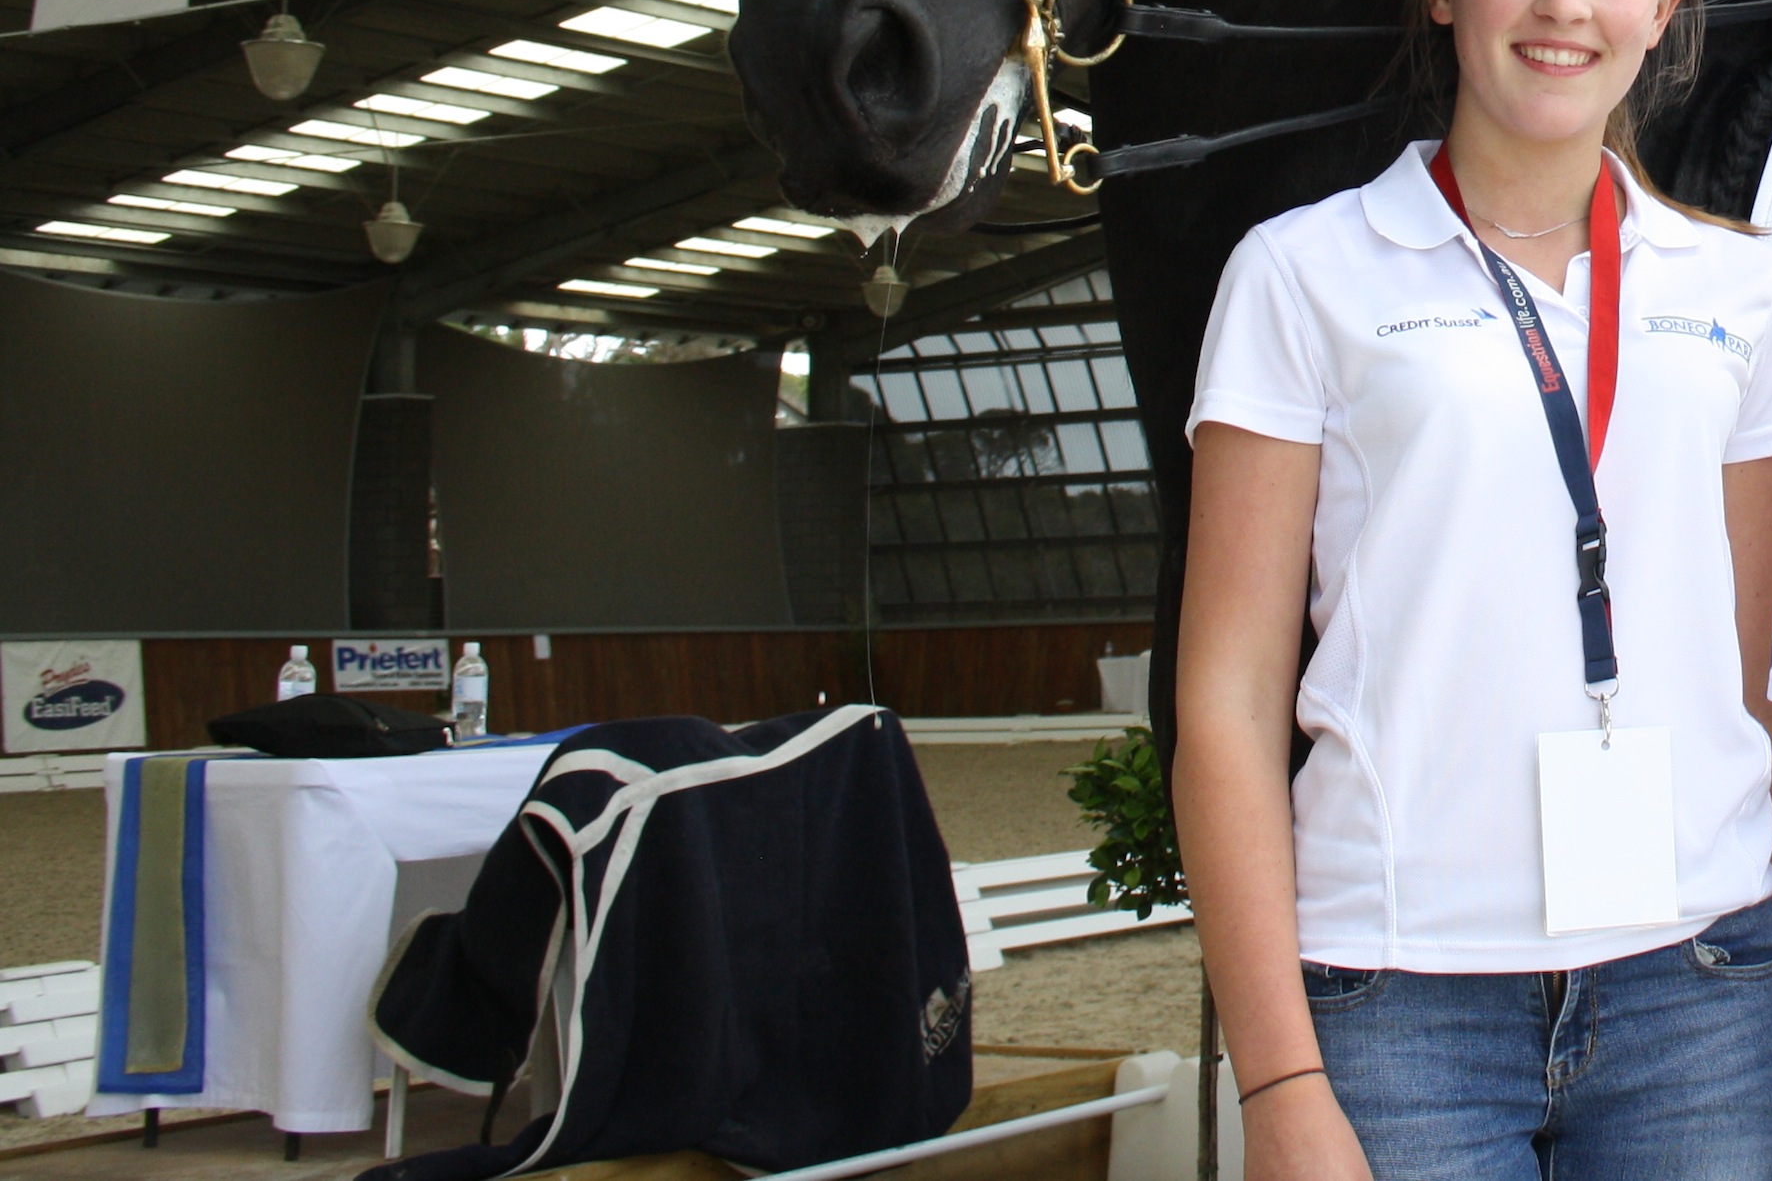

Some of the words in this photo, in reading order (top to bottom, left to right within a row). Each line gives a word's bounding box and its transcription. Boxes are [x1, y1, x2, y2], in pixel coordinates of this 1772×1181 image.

[1376, 319, 1431, 337] CREDIT
[1434, 317, 1482, 327] SUISSE
[1648, 319, 1707, 336] BONEO
[1728, 336, 1749, 356] PAR
[337, 643, 443, 670] Priefert
